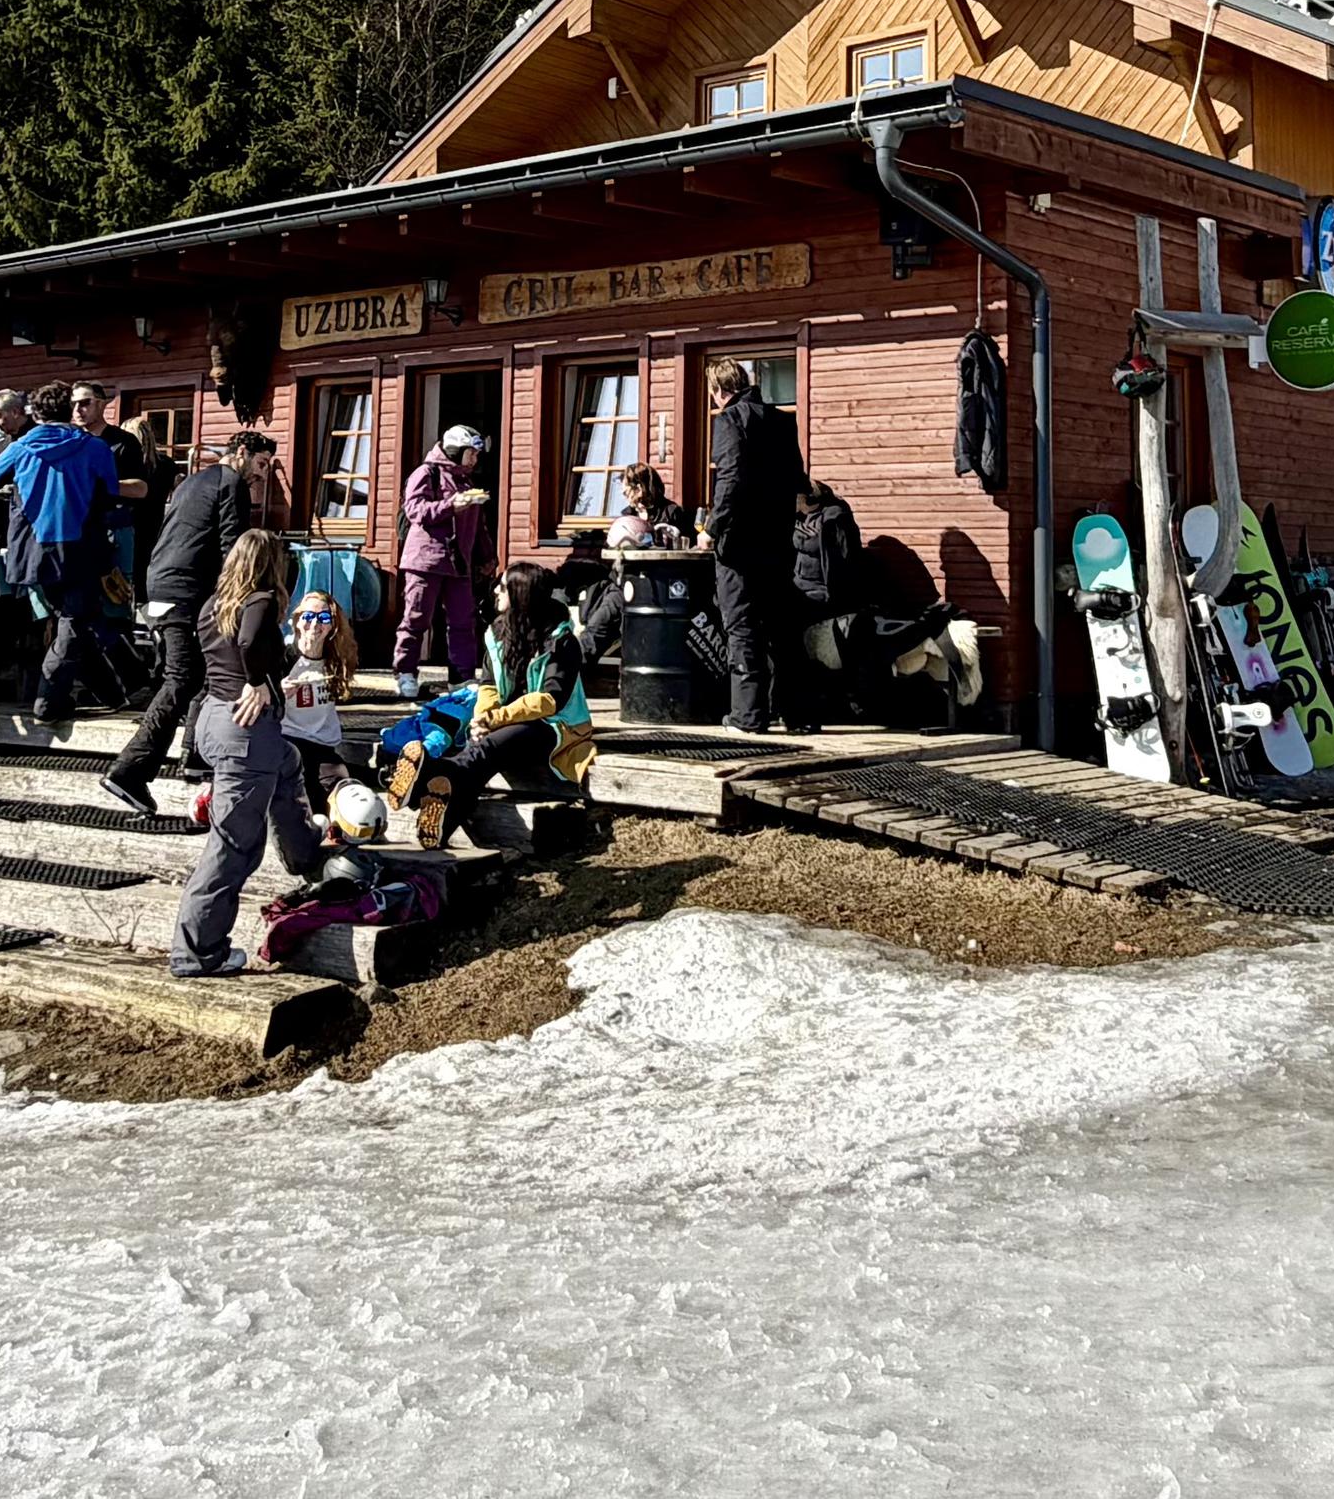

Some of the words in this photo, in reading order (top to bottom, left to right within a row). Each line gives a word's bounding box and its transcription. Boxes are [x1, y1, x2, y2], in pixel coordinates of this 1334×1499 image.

[609, 265, 667, 299] BAR
[695, 250, 774, 293] CAFE
[1287, 317, 1330, 337] CAFÉ
